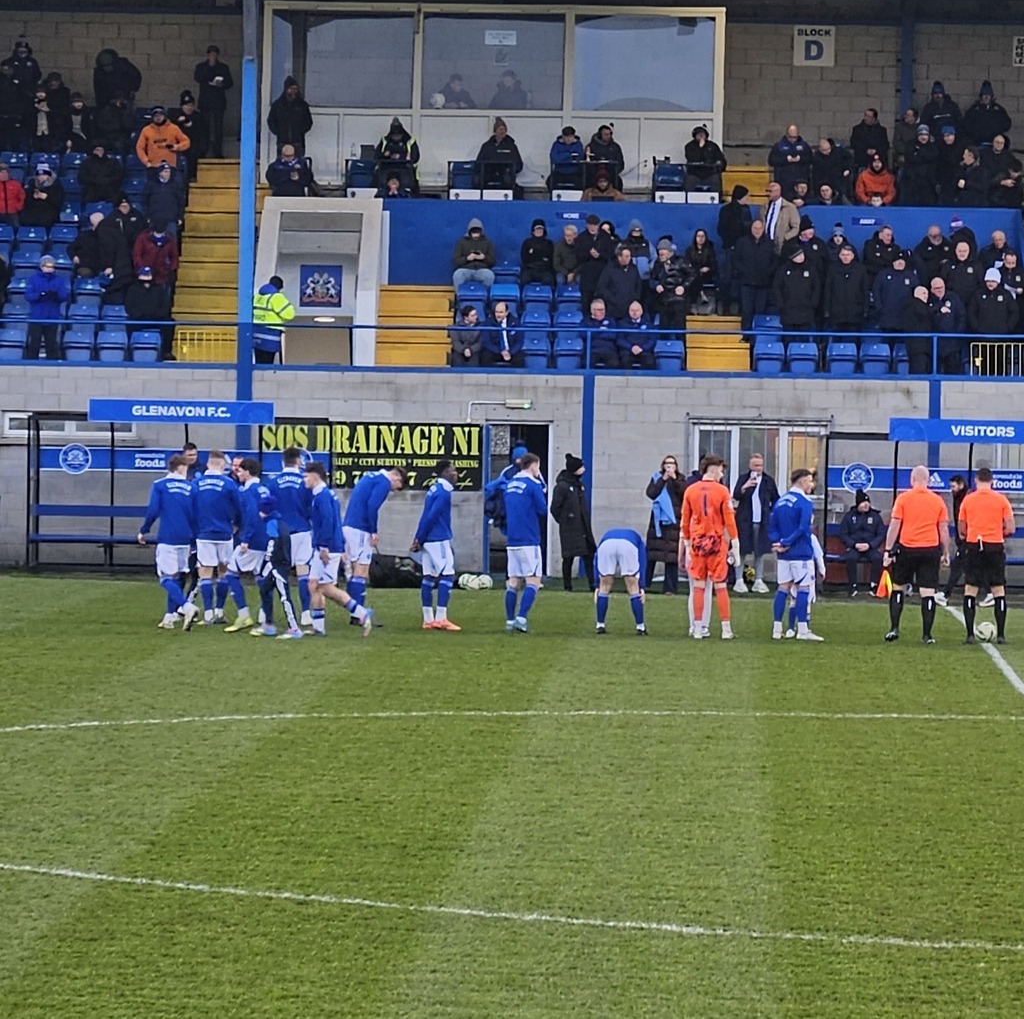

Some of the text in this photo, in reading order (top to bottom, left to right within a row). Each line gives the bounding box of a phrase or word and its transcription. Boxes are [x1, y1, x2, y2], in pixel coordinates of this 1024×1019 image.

[804, 40, 824, 60] D
[132, 405, 231, 418] GLENAVON F.C.
[951, 425, 1015, 438] VISITORS
[262, 425, 480, 456] SOS DRAINAGE NI
[134, 458, 166, 468] foods
[359, 458, 376, 466] CCTV
[376, 458, 406, 466] SURVEYS
